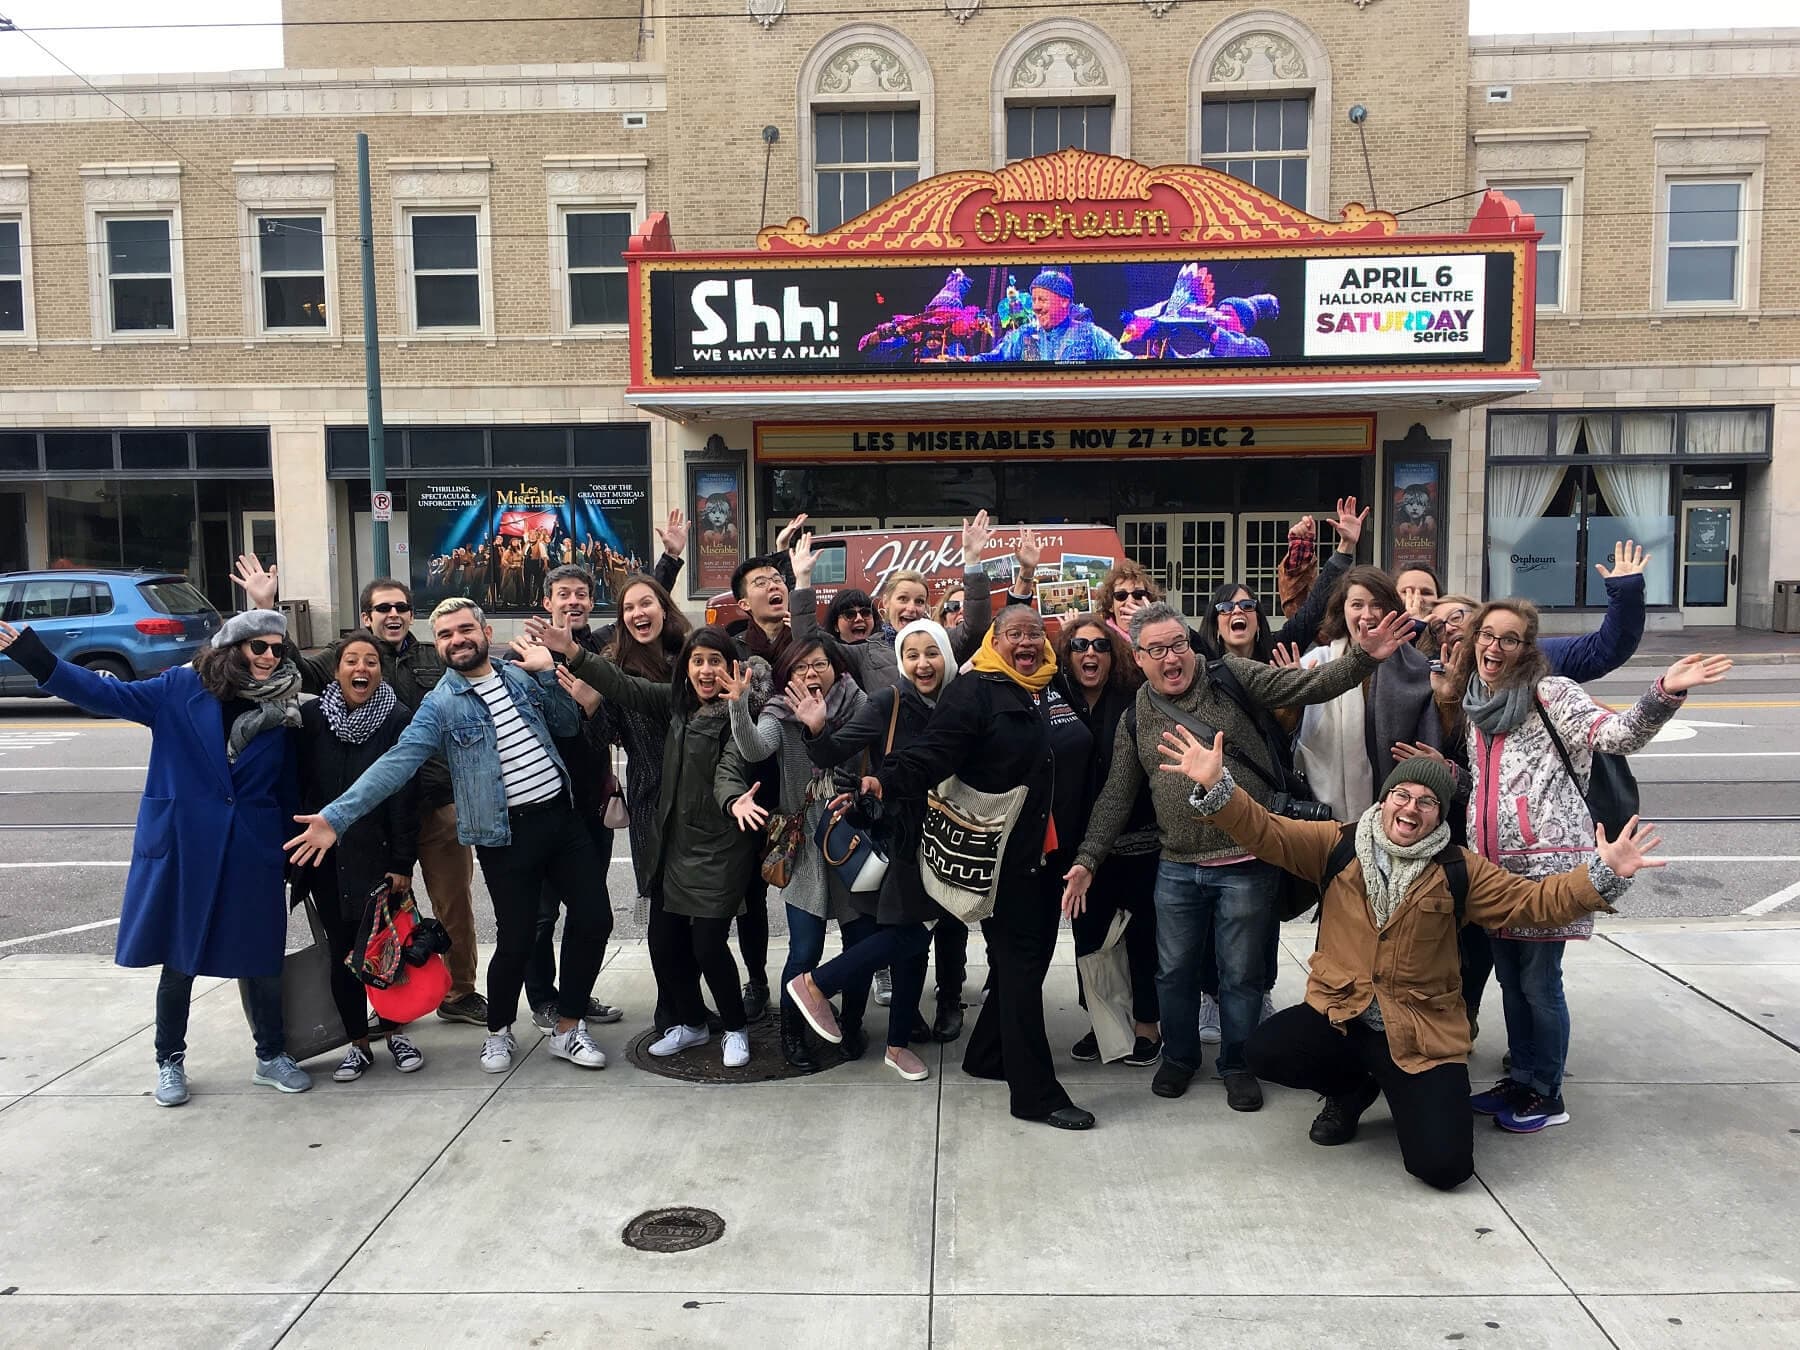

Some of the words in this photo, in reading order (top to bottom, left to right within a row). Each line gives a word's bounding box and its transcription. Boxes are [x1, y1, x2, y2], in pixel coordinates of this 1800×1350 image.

[975, 205, 1170, 244] Orpheum
[1340, 267, 1427, 290] APRIL
[1435, 265, 1453, 287] 6
[1319, 291, 1406, 306] HALLORAN
[1411, 290, 1474, 303] CENTRE
[690, 278, 839, 345] Shh!
[1316, 309, 1474, 334] SATURDAY
[1413, 328, 1469, 343] series
[692, 348, 722, 361] WE
[727, 347, 777, 361] HAVE
[781, 347, 796, 359] A
[799, 345, 840, 359] PLAN
[852, 431, 895, 452] LES
[907, 430, 1056, 451] MISERABLES
[1069, 428, 1117, 449] NOV
[1127, 428, 1155, 448] 27
[1181, 427, 1229, 447] DEC
[1239, 426, 1256, 447] 2
[520, 482, 539, 495] Les
[1510, 554, 1556, 566] Orpheum
